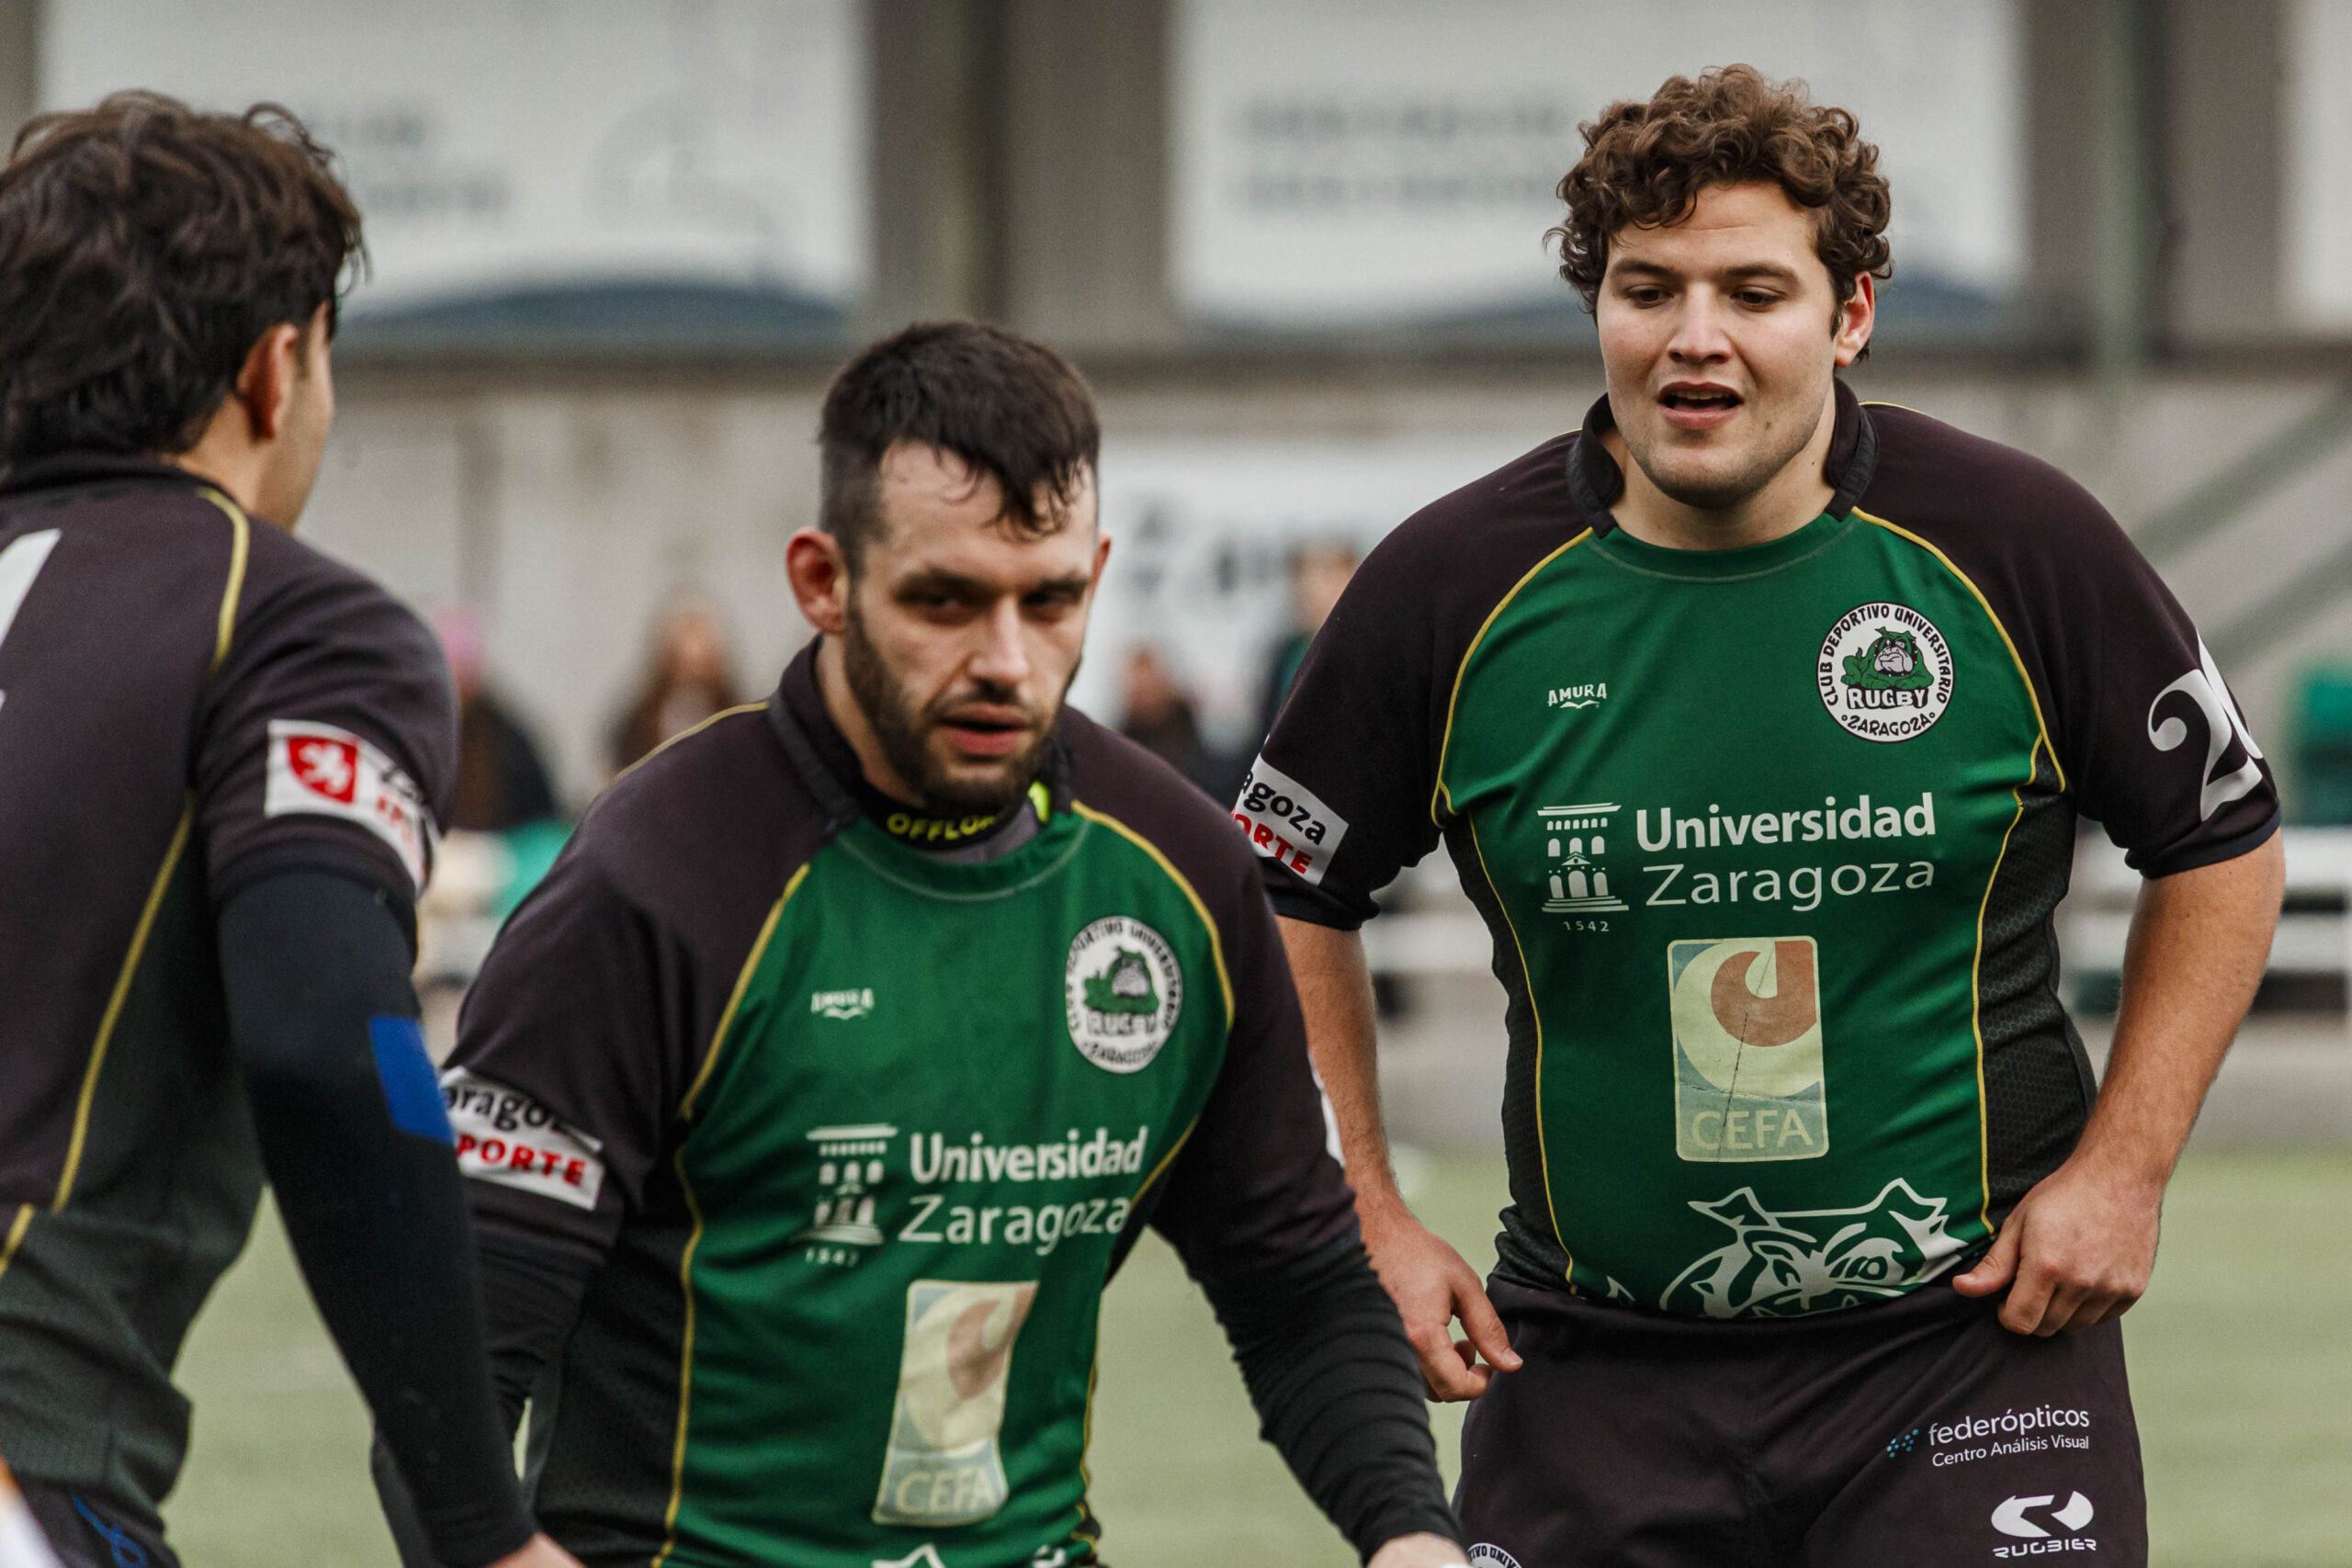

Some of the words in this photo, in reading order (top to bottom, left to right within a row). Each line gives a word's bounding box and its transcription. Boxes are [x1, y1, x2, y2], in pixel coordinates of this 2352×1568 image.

[1823, 604, 1890, 658] DEPORTIVO
[1894, 607, 1952, 705] UNIVERSITARIO
[1547, 682, 1607, 706] AMURA
[1820, 661, 1838, 706] CLUB
[1847, 688, 1929, 709] RUGBY
[1848, 713, 1932, 736] ZARAGOZA
[1636, 792, 1936, 852] Universidad
[1642, 860, 1935, 911] Zaragoza
[1563, 920, 1610, 932] 1542
[1691, 1108, 1815, 1149] CEFA
[910, 1125, 1148, 1183] Universidad
[898, 1195, 1132, 1256] Zaragoza
[1928, 1404, 2090, 1446] federópticos
[1932, 1448, 1986, 1467] Centro
[1991, 1438, 2048, 1457] Análisis
[2051, 1435, 2089, 1450] Visual
[896, 1468, 996, 1514] CEFA
[1993, 1538, 2097, 1558] RUGBIER
